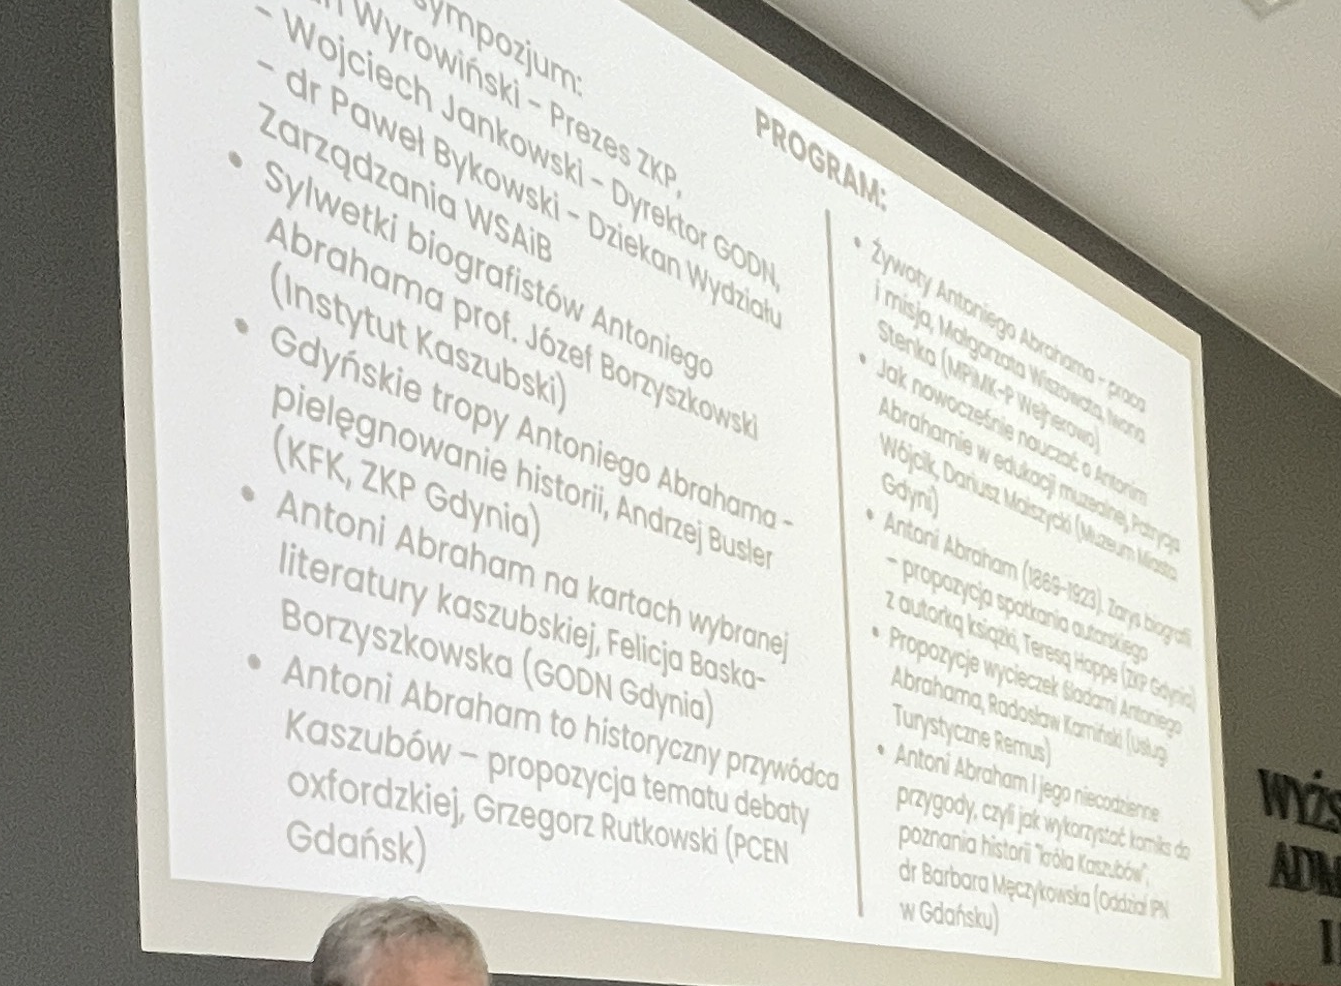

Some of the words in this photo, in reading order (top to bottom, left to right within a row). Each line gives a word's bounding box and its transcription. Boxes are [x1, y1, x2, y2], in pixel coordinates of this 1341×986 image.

[279, 4, 433, 113] Wojciech
[440, 92, 584, 189] Jankowski
[610, 175, 708, 250] Dyrektor
[712, 232, 781, 294] GODN,
[351, 0, 520, 110] Wyrowiński
[549, 99, 632, 168] Prezes
[635, 145, 682, 200] ZKP,
[754, 105, 888, 212] PROGRAM:
[257, 100, 457, 222] Zarządzania
[463, 196, 553, 264] WSAiB
[285, 66, 322, 105] dr
[329, 83, 425, 159] Paweł
[432, 134, 560, 222] Bykowski
[587, 209, 682, 281] Dziekan
[684, 258, 782, 331] Wydziału
[264, 159, 398, 244] Sylwetki
[406, 219, 585, 323] biografistów
[589, 304, 714, 381] Antoniego
[264, 215, 445, 314] Abrahama
[451, 295, 518, 344] prof.
[524, 321, 593, 374] Józef
[599, 349, 759, 442] Borzyszkowski
[269, 259, 409, 350] (Instytut
[415, 323, 567, 416] Kaszubski)
[269, 324, 422, 404] Gdyńskie
[431, 381, 510, 443] tropy
[514, 413, 651, 488] Antoniego
[655, 464, 777, 530] Abrahama
[270, 382, 508, 483] pielęgnowanie
[515, 456, 609, 522] historii,
[615, 493, 703, 557] Andrzej
[706, 524, 774, 570] Busler
[272, 422, 352, 491] (KFK,
[360, 457, 417, 502] ZKP
[423, 479, 541, 548] Gdynia)
[275, 488, 386, 548] Antoni
[393, 522, 536, 589] Abraham
[542, 569, 579, 600] na
[586, 573, 682, 628] kartach
[687, 609, 789, 666] wybranej
[278, 539, 429, 618] literatury
[436, 581, 601, 661] kaszubskiej,
[606, 626, 684, 679] Felicja
[688, 648, 767, 691] Baska-
[280, 596, 513, 680] Borzyszkowska
[521, 644, 613, 702] (GODN
[618, 676, 714, 730] Gdynia)
[280, 653, 392, 705] Antoni
[399, 677, 542, 734] Abraham
[549, 708, 577, 741] to
[583, 713, 722, 776] historyczny
[724, 749, 840, 792] przywódca
[284, 707, 453, 766] Kaszubów
[486, 749, 636, 805] propozycja
[641, 771, 729, 814] tematu
[733, 787, 810, 835] debaty
[285, 818, 427, 874] Gdańsk)
[286, 766, 466, 829] oxfordzkiej,
[472, 791, 595, 842] Grzegorz
[600, 810, 718, 855] Rutkowski
[724, 822, 789, 865] (PCEN
